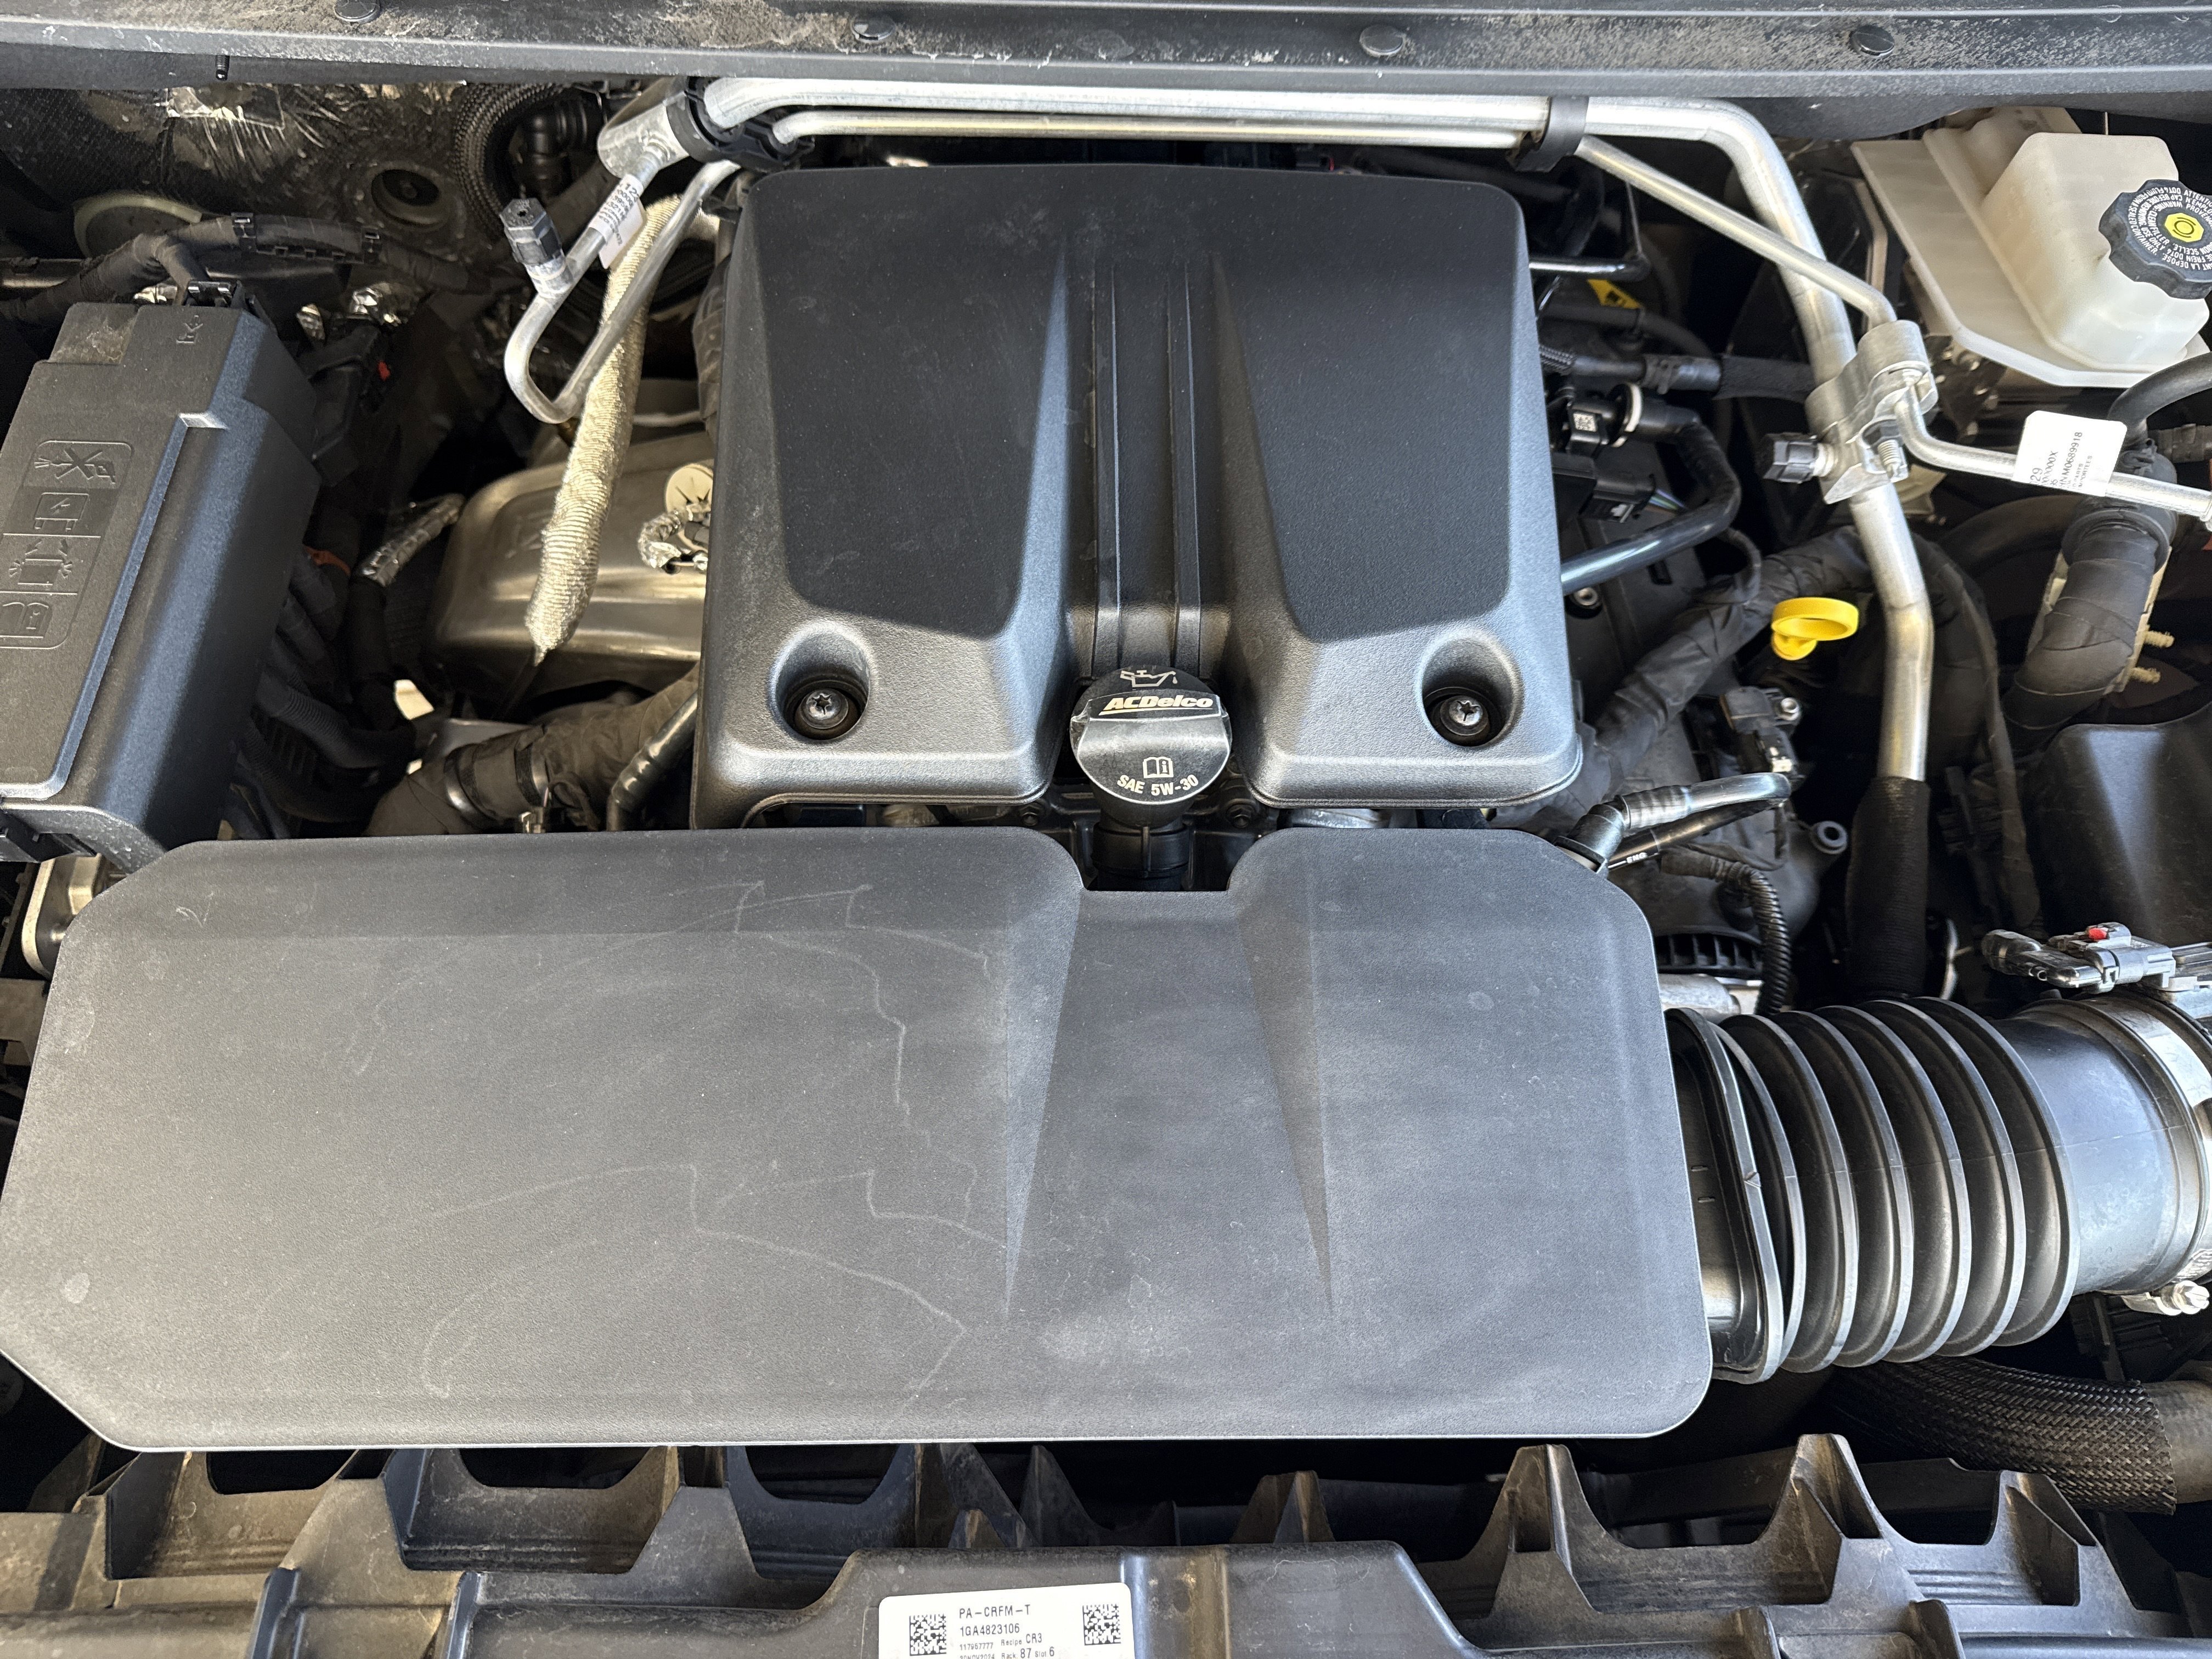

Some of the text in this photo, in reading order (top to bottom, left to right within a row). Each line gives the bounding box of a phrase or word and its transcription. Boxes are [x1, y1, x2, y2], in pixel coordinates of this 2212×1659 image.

[2147, 194, 2170, 205] BEFORE
[2141, 227, 2153, 238] USE
[2150, 227, 2170, 245] FILLER
[2149, 236, 2165, 250] ONLY
[2162, 252, 2188, 268] DEPOSE.
[1103, 695, 1214, 710] ACDelco
[1117, 775, 1199, 795] SAE 5W-30
[960, 1623, 1020, 1637] 1GA4823106
[1026, 1633, 1042, 1644] CR3
[1020, 1648, 1031, 1658] 87
[1049, 1646, 1055, 1657] 6
